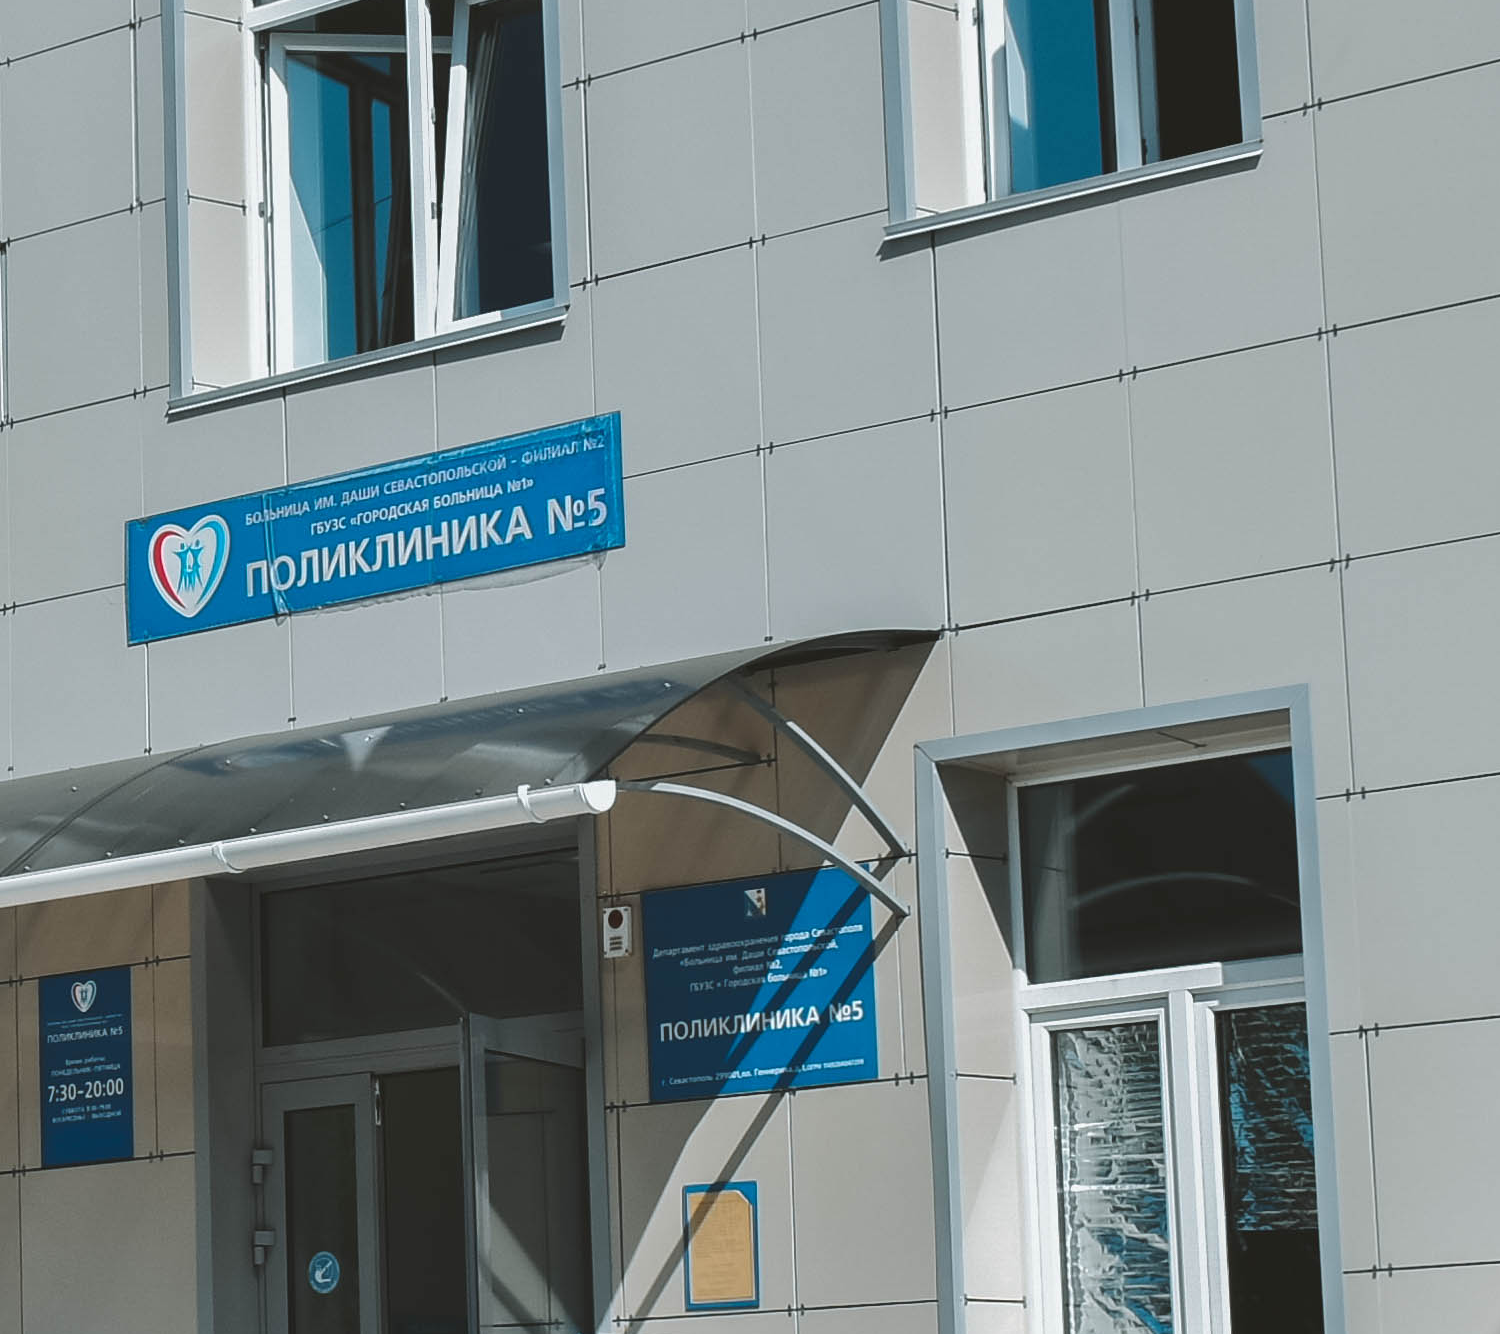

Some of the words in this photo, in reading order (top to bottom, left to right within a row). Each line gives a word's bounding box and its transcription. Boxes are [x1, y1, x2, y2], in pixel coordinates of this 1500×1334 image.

[245, 501, 310, 526] БОЛЬНИЦА
[313, 496, 338, 511] ИМ.
[340, 485, 380, 507] ДАШИ
[383, 455, 507, 495] СЕВАСТОПОЛЬСКОЙ
[521, 441, 579, 465] ФИЛИАЛ
[583, 434, 606, 452] №2
[310, 517, 347, 536] ГБУЗС
[350, 498, 429, 527] «ГОРОДСКАЯ
[433, 482, 503, 509] БОЛЬНИЦА
[507, 477, 534, 494] №1»
[246, 505, 533, 598] ПОЛИКЛИНИКА
[546, 488, 609, 535] №5
[659, 1004, 821, 1043] ПОЛИКЛИНИКА
[828, 999, 864, 1024] №5
[47, 1077, 124, 1103] 7:30-20:00
